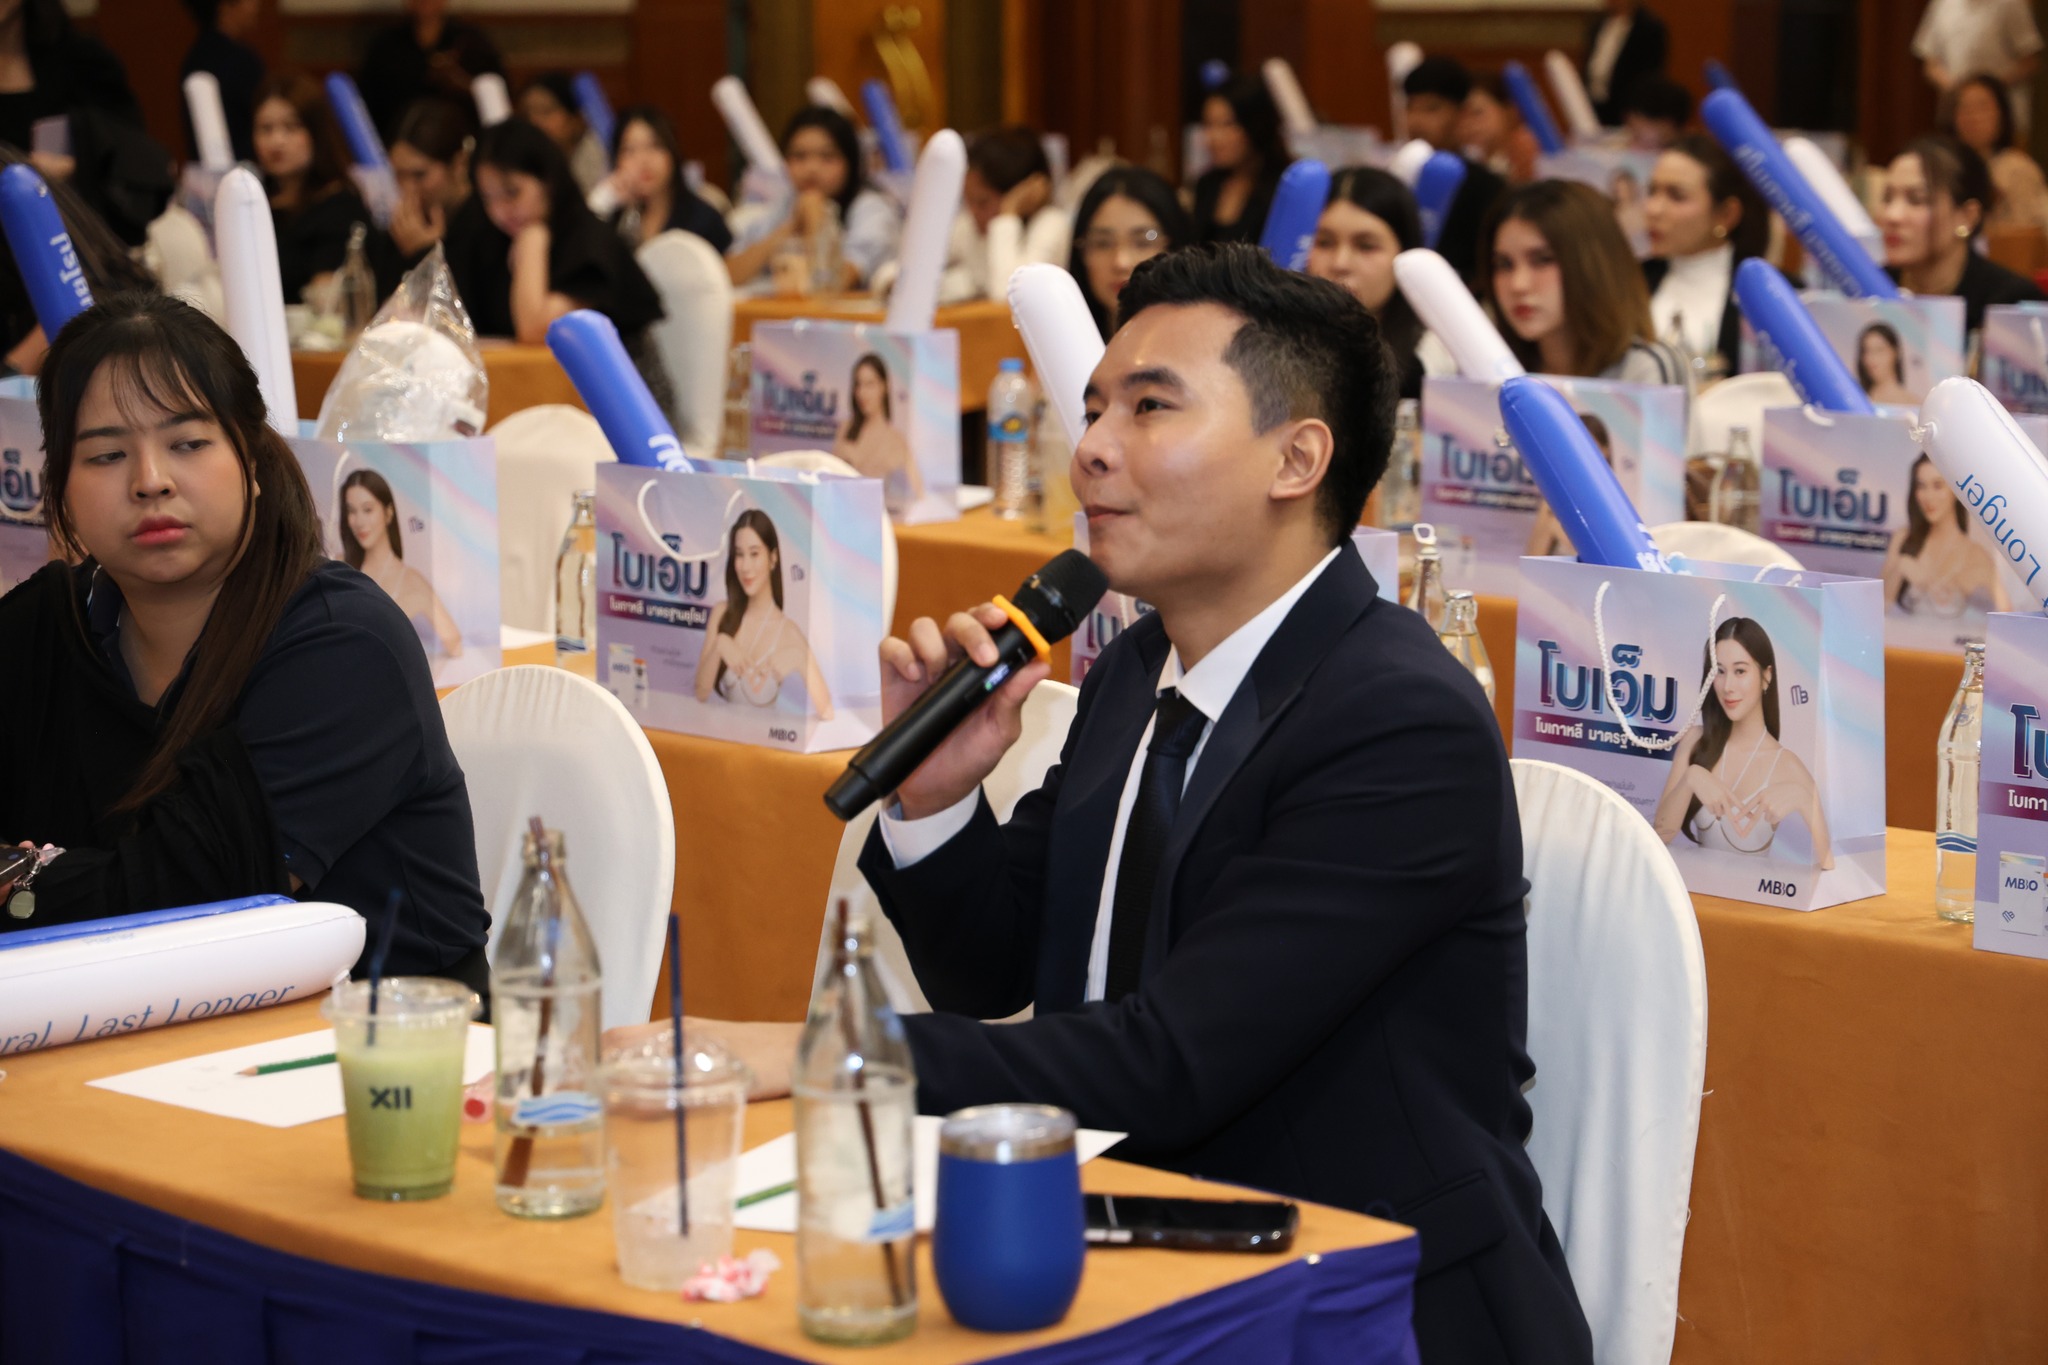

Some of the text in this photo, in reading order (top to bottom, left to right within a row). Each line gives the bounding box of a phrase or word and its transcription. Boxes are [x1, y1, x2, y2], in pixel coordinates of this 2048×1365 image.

[1780, 468, 1888, 525] โบเอ็ม
[1955, 474, 2041, 586] Longer
[611, 532, 708, 598] โบเอ็ม
[1537, 640, 1678, 723] โบเอ็ม
[1535, 716, 1674, 754] โบเกาหลี มาตรฐยุโรป
[0, 986, 295, 1054] ral Last Longer
[369, 1086, 411, 1110] XII
